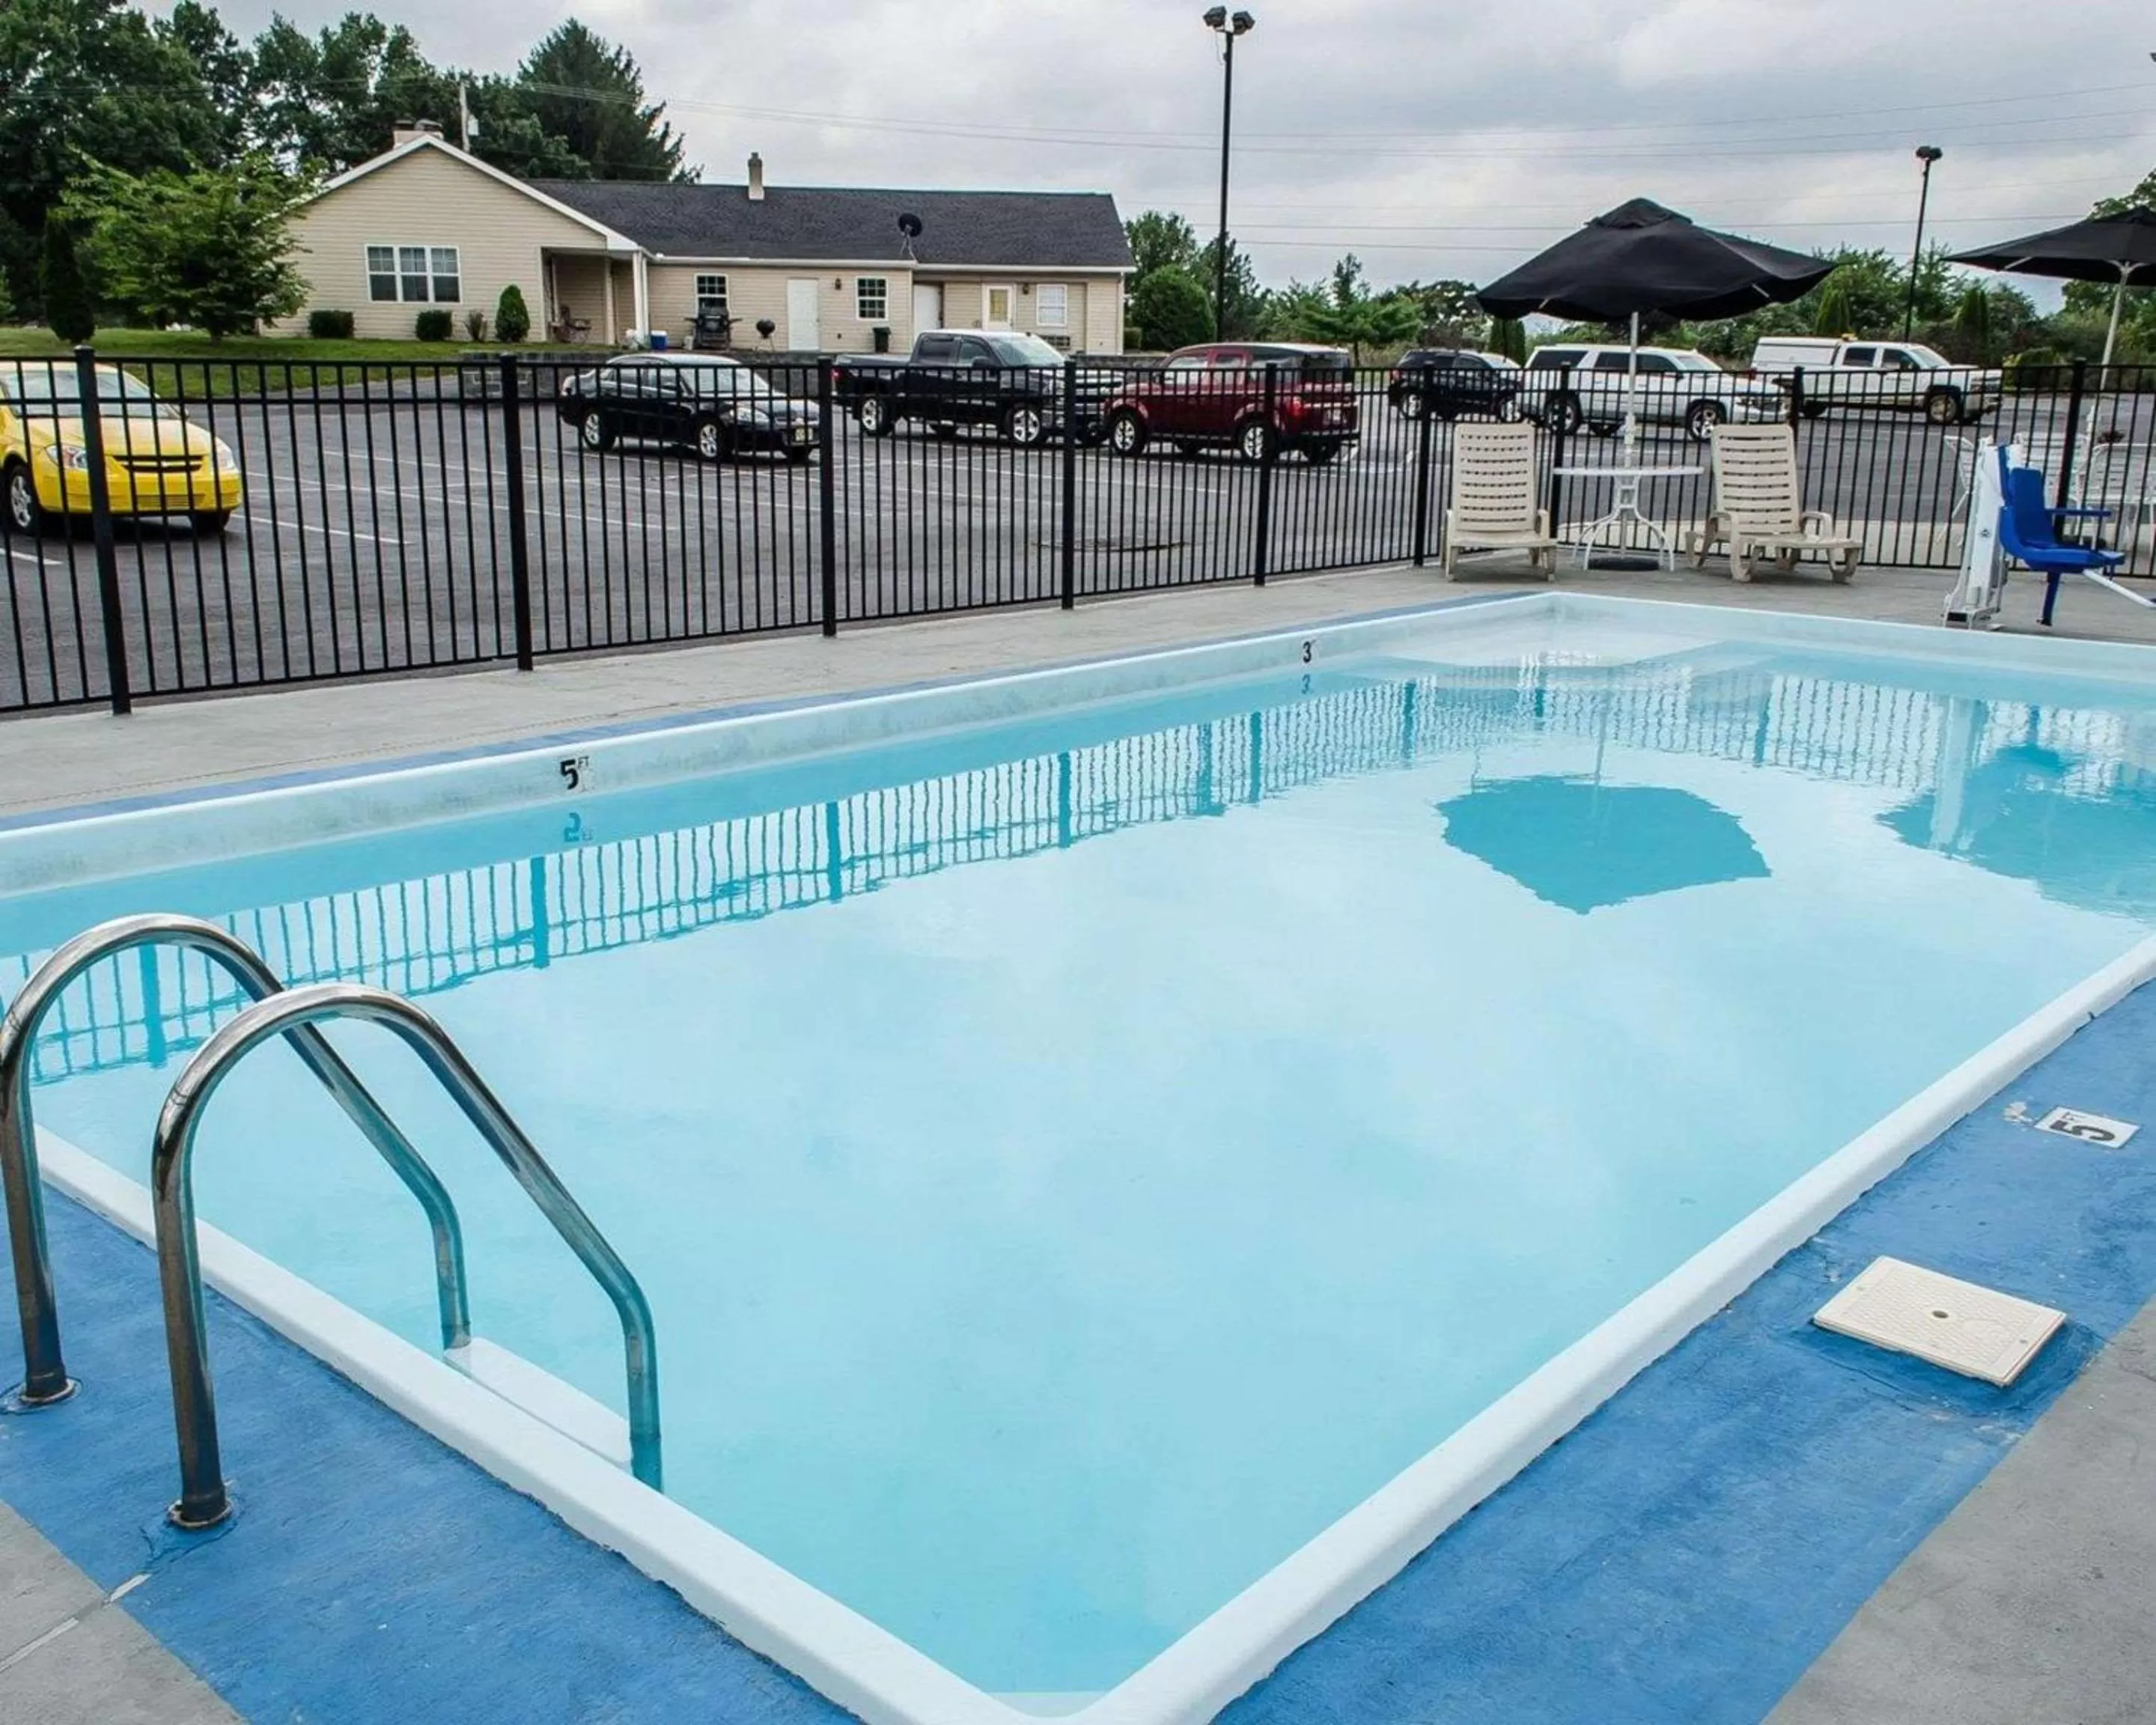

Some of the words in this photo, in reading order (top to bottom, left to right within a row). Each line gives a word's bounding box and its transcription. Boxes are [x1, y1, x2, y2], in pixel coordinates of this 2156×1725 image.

[1303, 641, 1312, 663] 3
[560, 758, 579, 790] 5
[2049, 1120, 2116, 1141] 5
